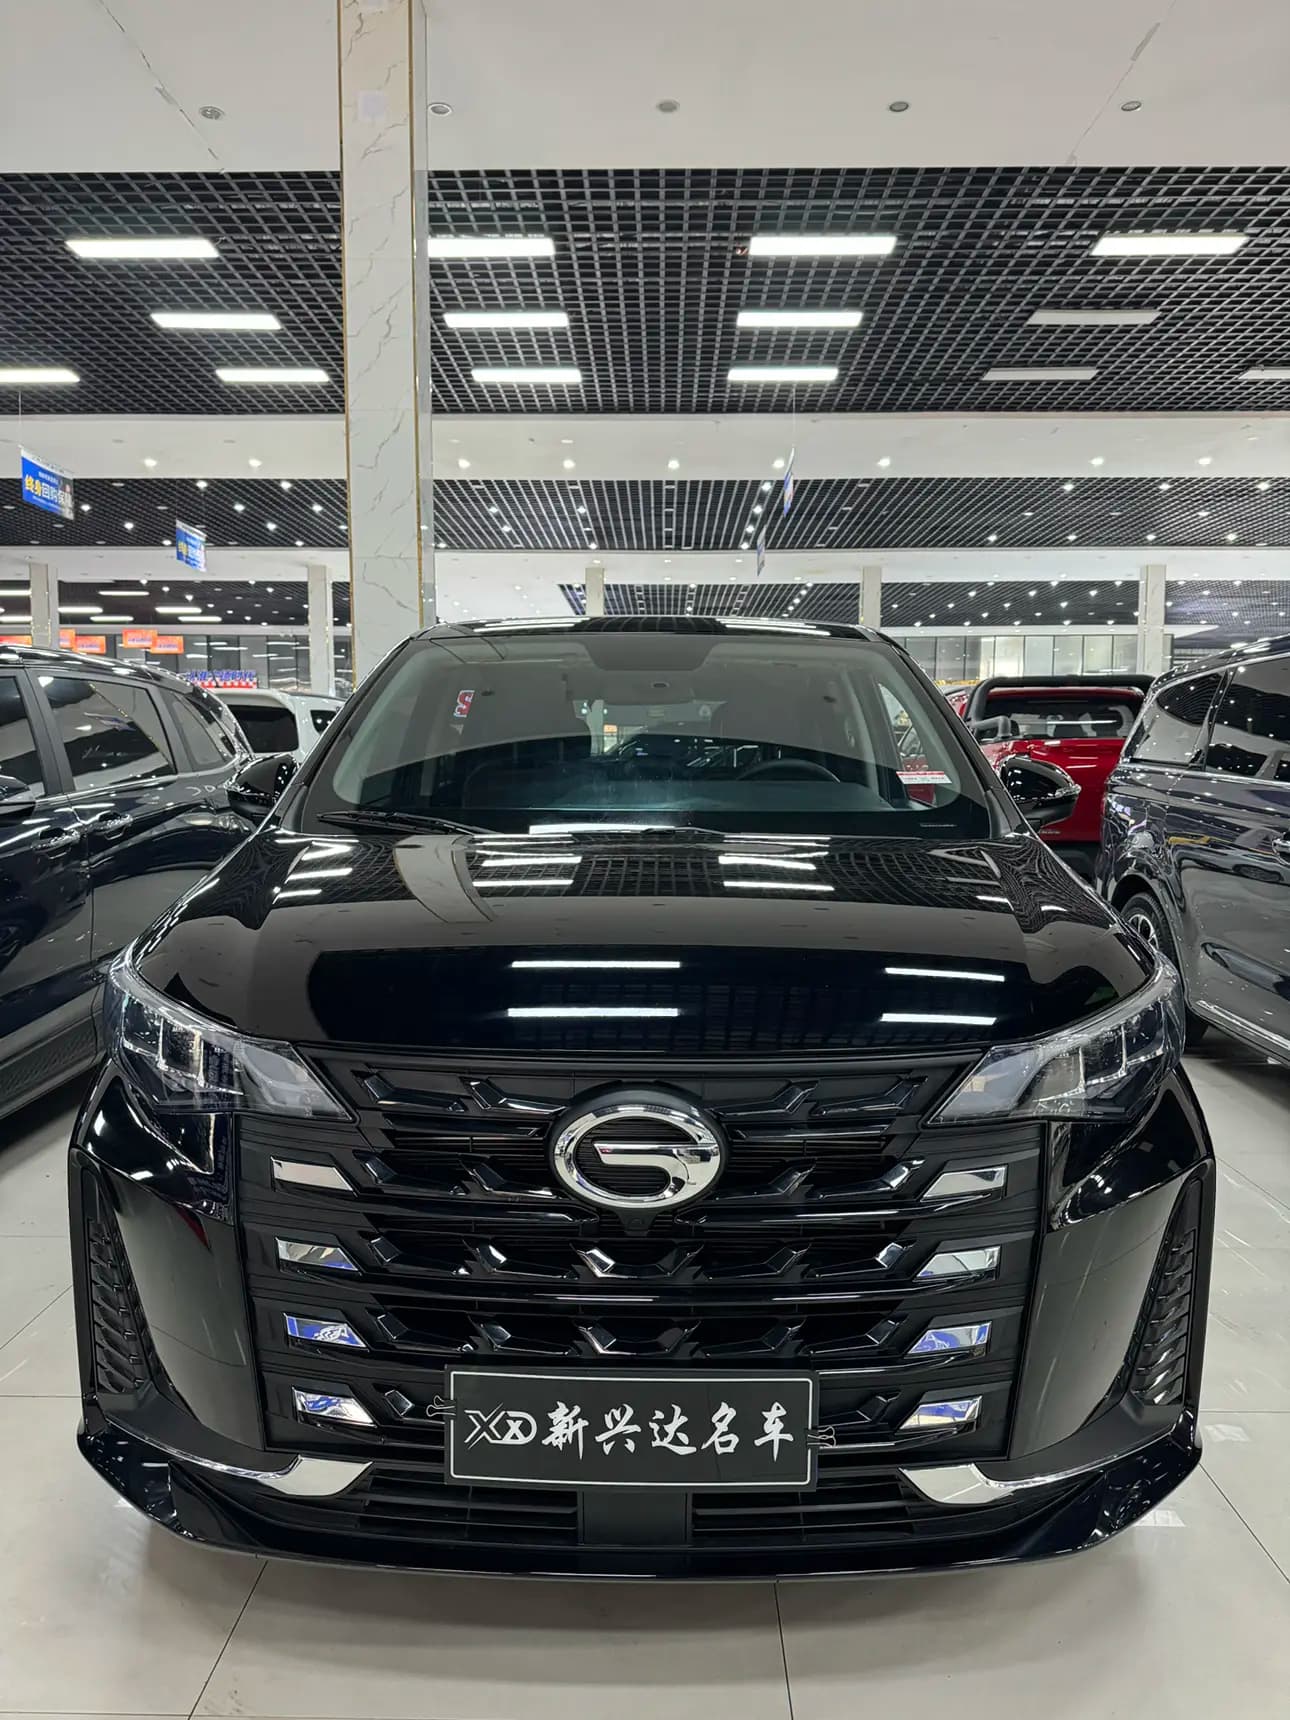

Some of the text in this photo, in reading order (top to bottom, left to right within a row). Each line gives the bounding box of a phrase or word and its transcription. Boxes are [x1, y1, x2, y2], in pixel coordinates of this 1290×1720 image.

[541, 1401, 795, 1462] 新兴达名车
